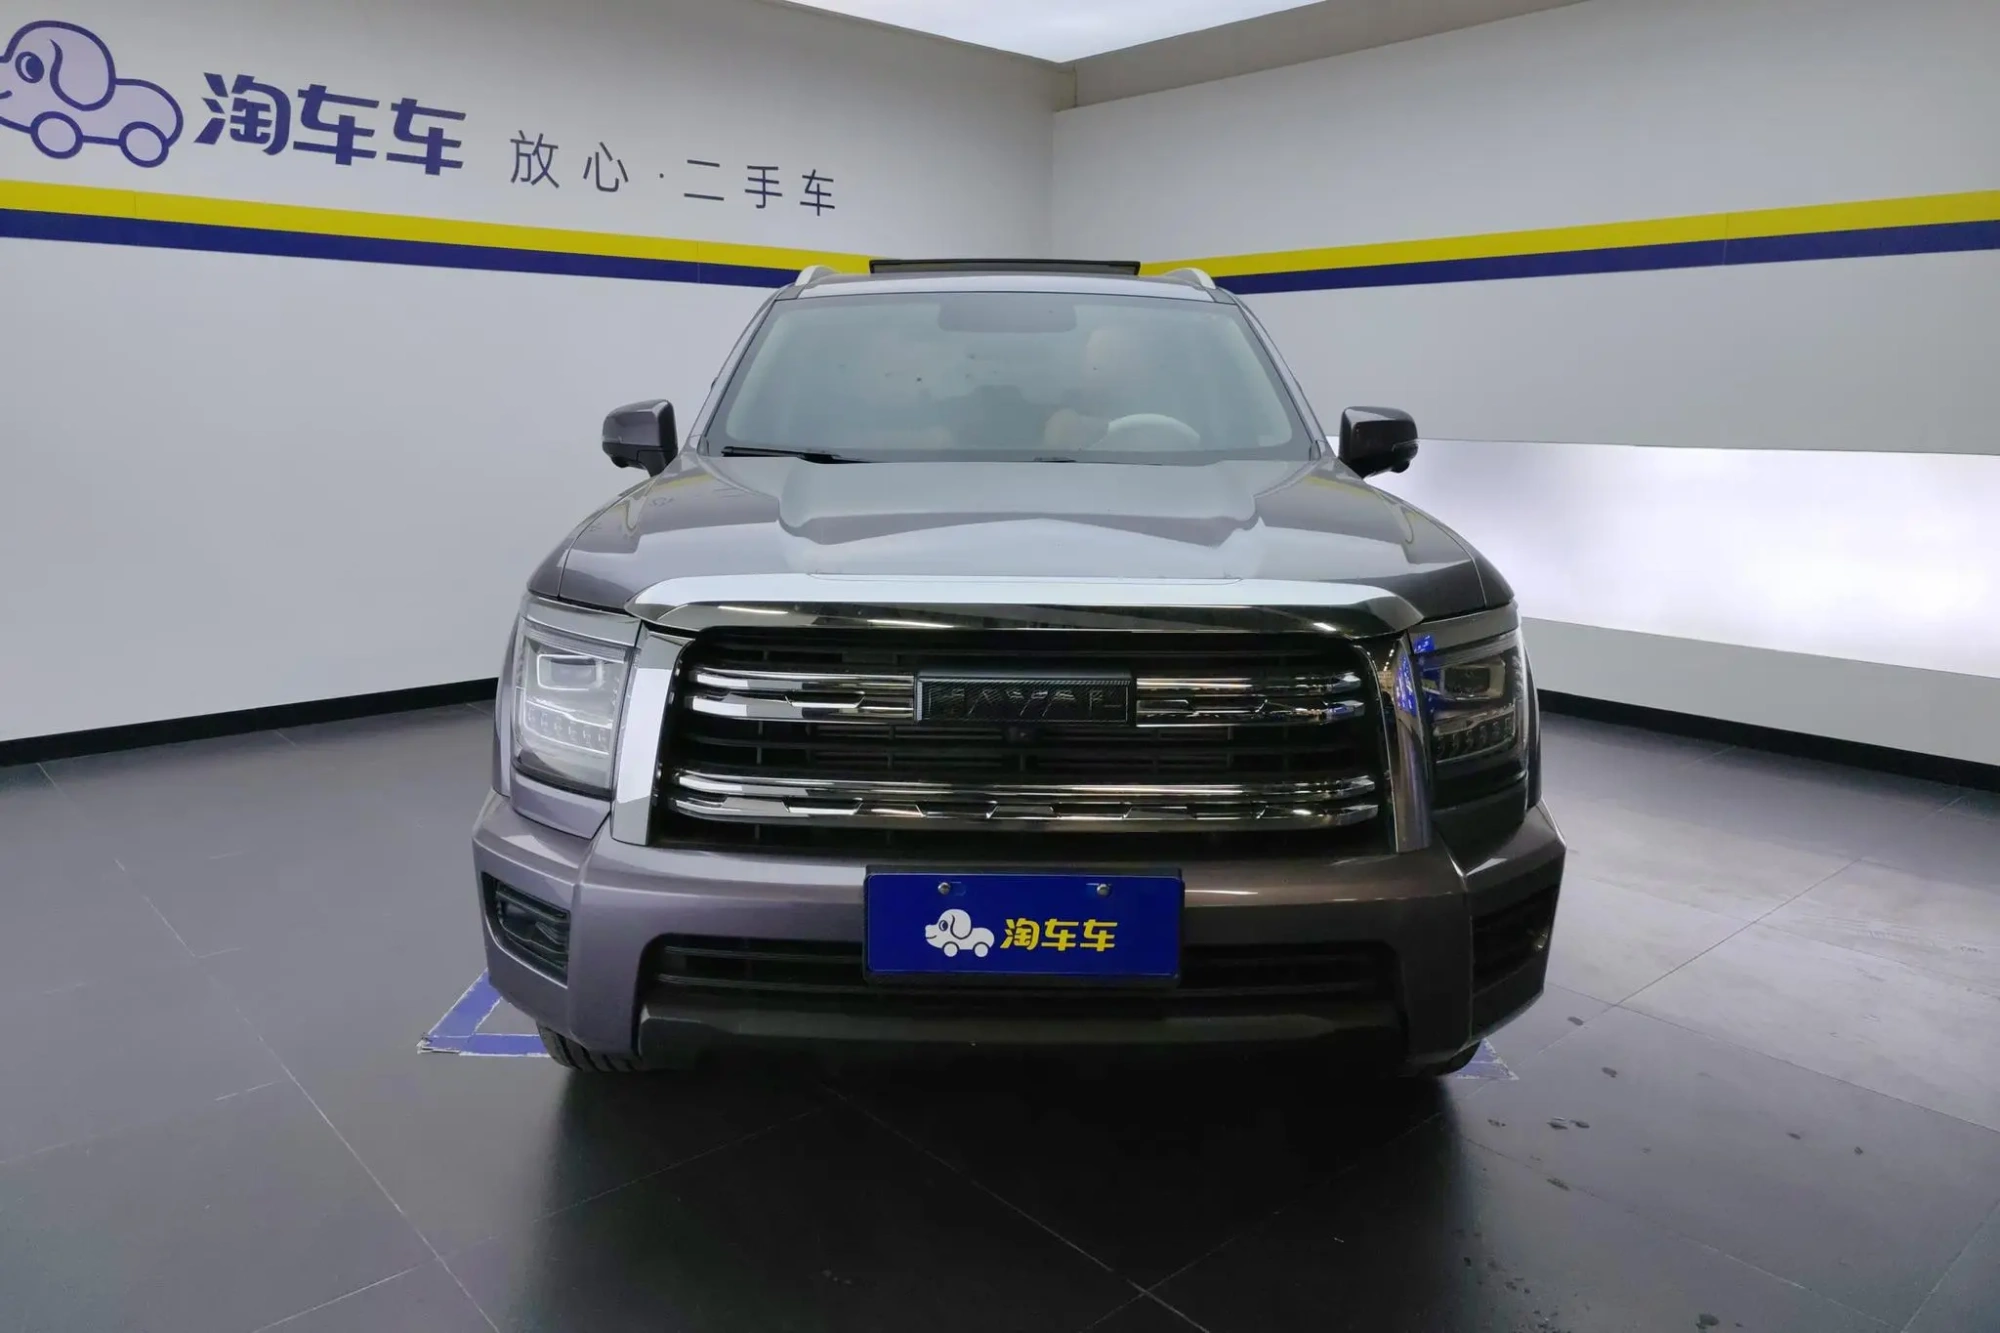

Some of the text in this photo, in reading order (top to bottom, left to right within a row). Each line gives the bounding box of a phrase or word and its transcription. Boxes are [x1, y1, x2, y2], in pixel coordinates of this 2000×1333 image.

[194, 72, 466, 175] 淘车车
[1000, 918, 1118, 951] 淘车车
